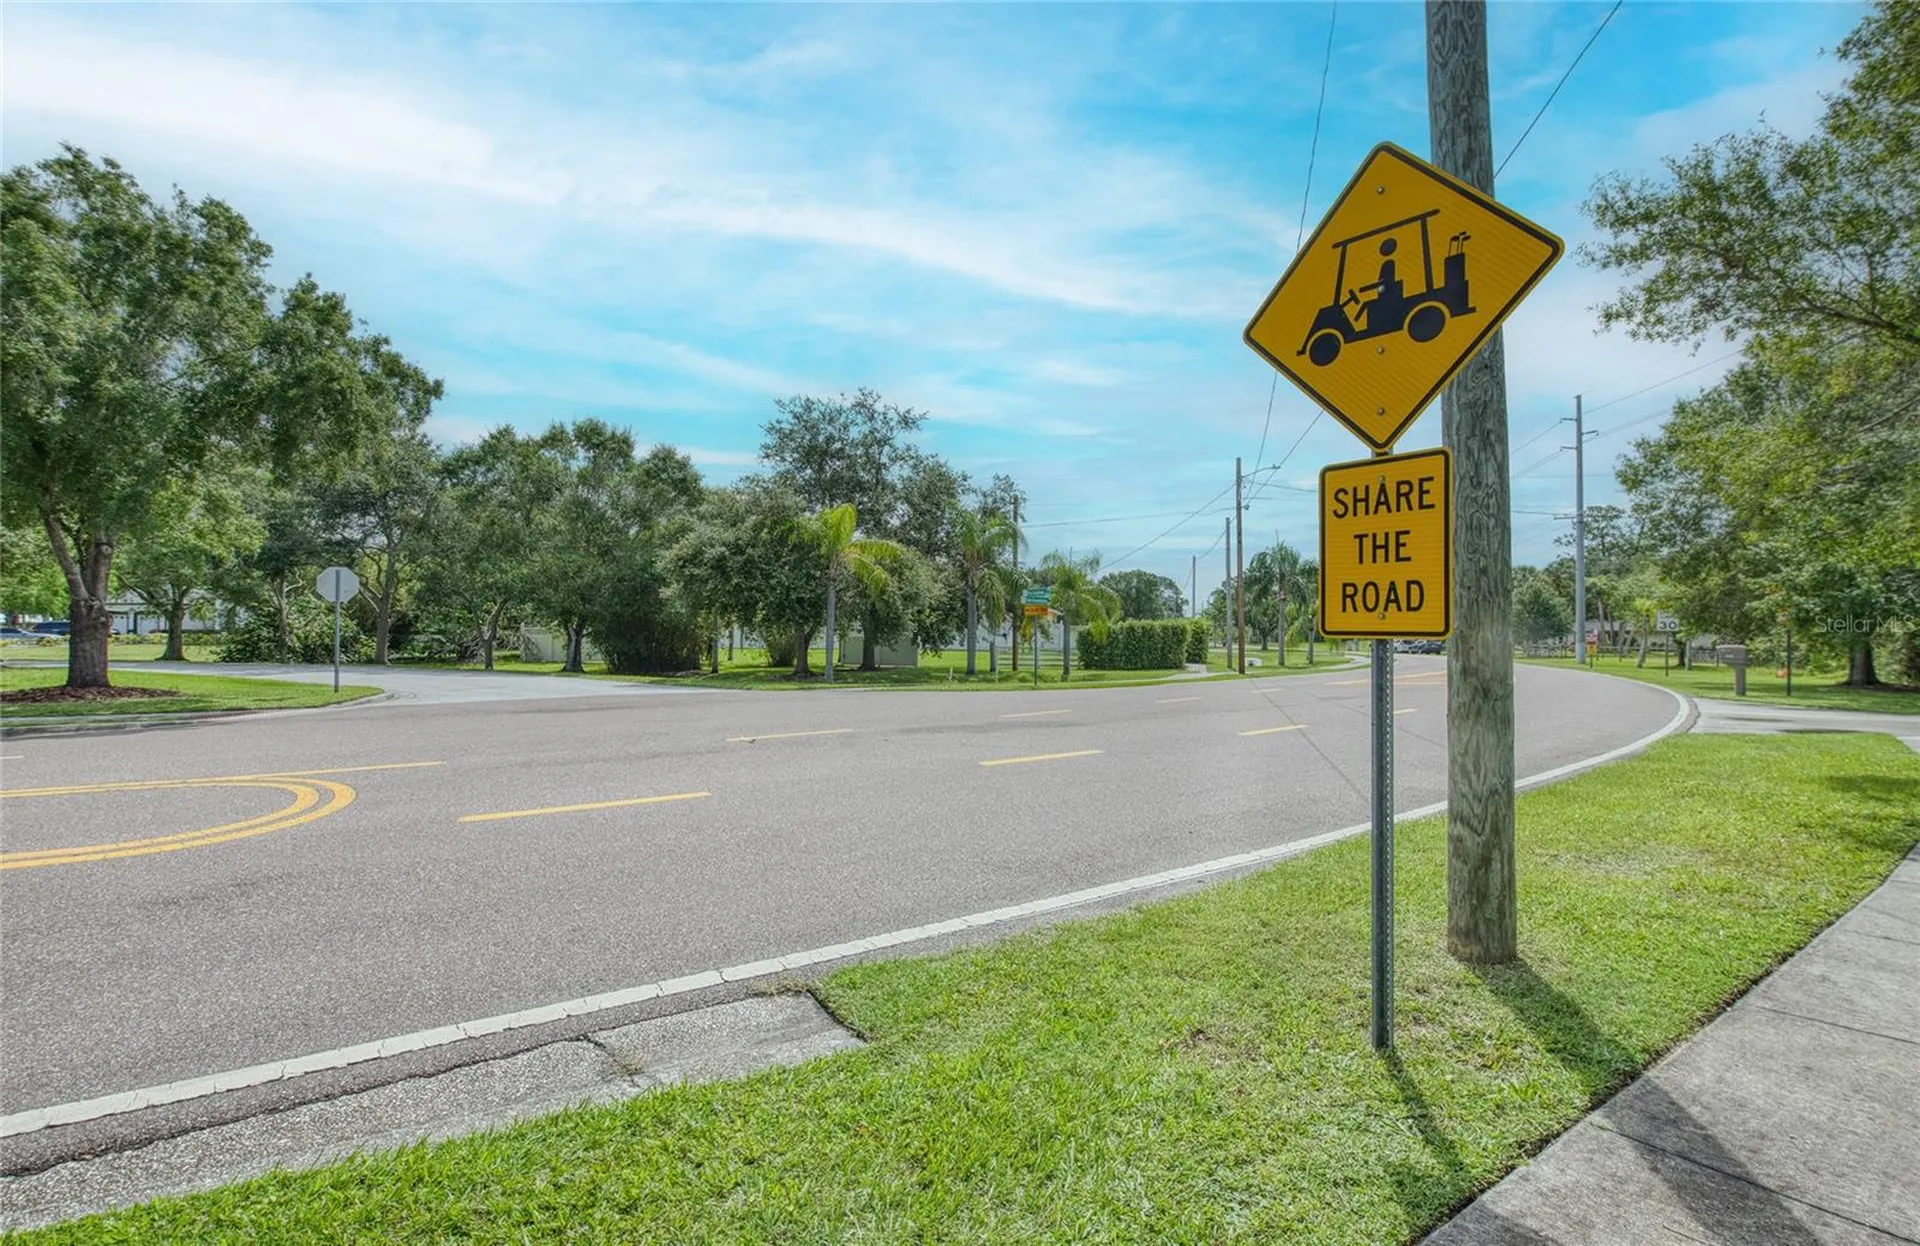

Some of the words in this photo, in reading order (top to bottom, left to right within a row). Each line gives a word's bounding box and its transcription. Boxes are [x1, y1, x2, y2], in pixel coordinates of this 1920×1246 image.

[1333, 476, 1436, 519] SHARE
[1353, 530, 1412, 565] THE
[1341, 579, 1425, 613] ROAD
[1659, 620, 1678, 630] 30
